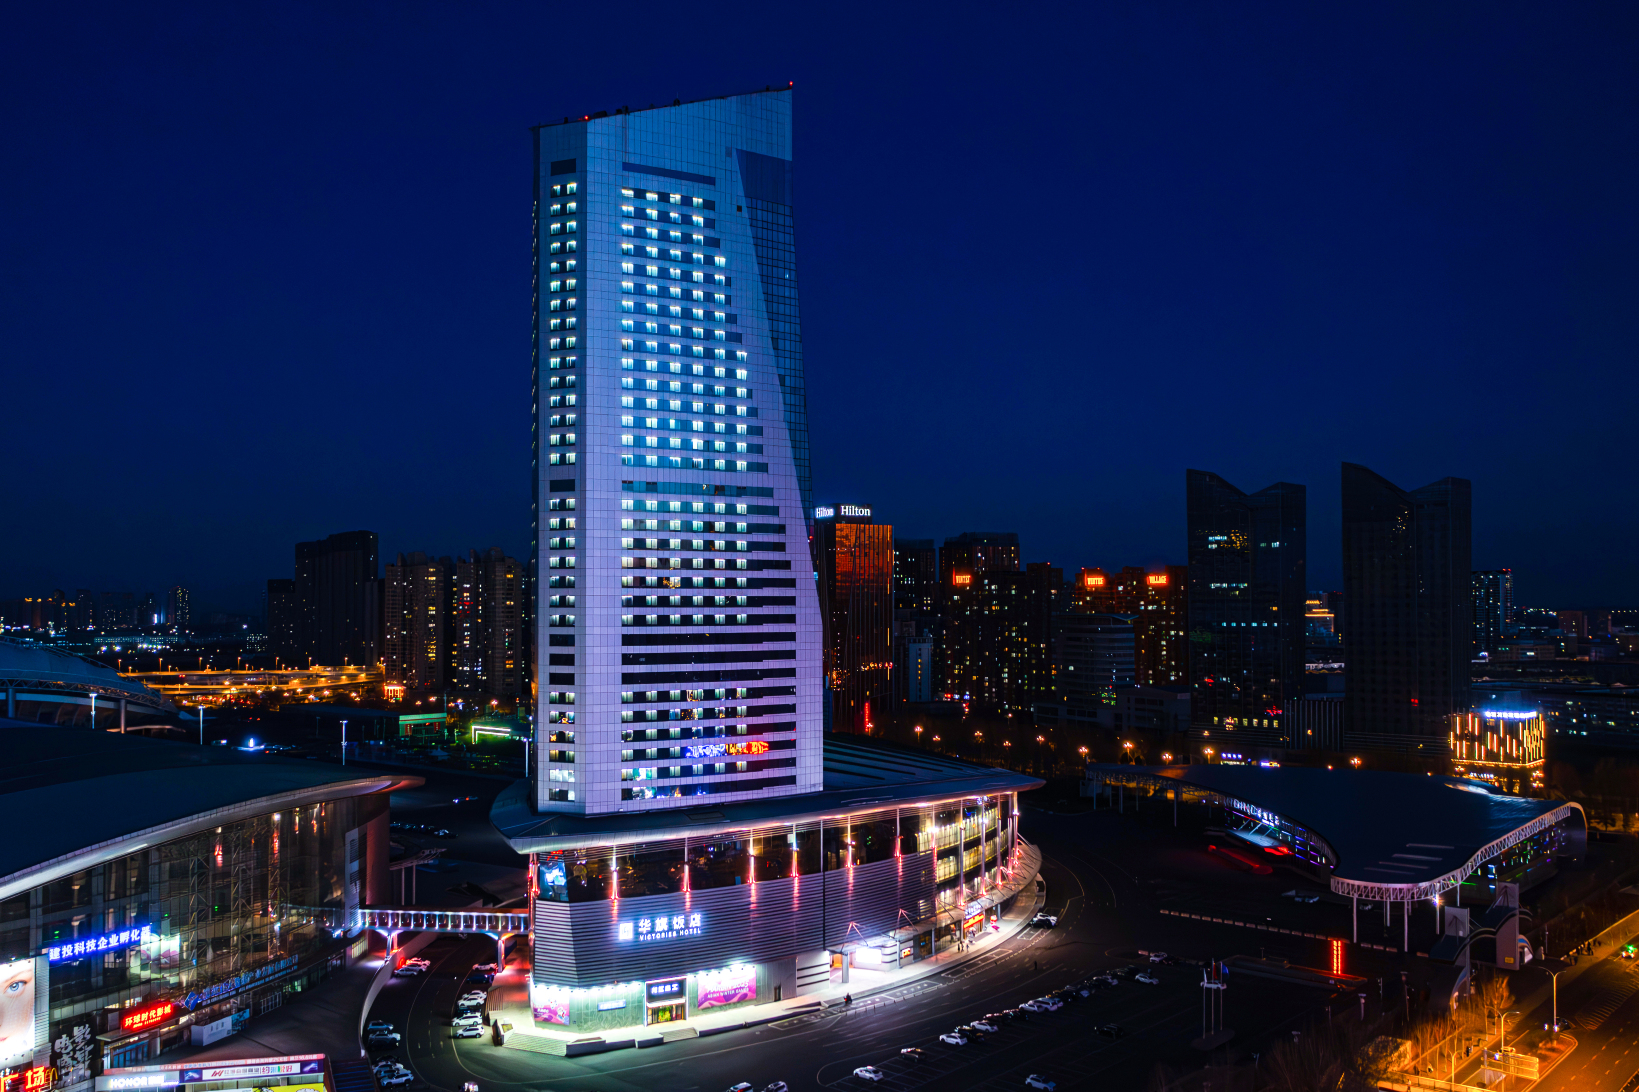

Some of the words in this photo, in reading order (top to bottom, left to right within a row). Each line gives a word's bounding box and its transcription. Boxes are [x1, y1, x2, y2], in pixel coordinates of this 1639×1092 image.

[816, 507, 834, 518] Hilton
[841, 505, 871, 516] Hilton
[638, 912, 702, 935] 华旗饭店
[679, 927, 702, 937] HOTEL
[49, 925, 151, 961] 建投科技企业孵化器
[124, 1003, 172, 1027] 环球时代影城
[0, 1065, 45, 1092] 广场
[110, 1076, 147, 1089] HONOR
